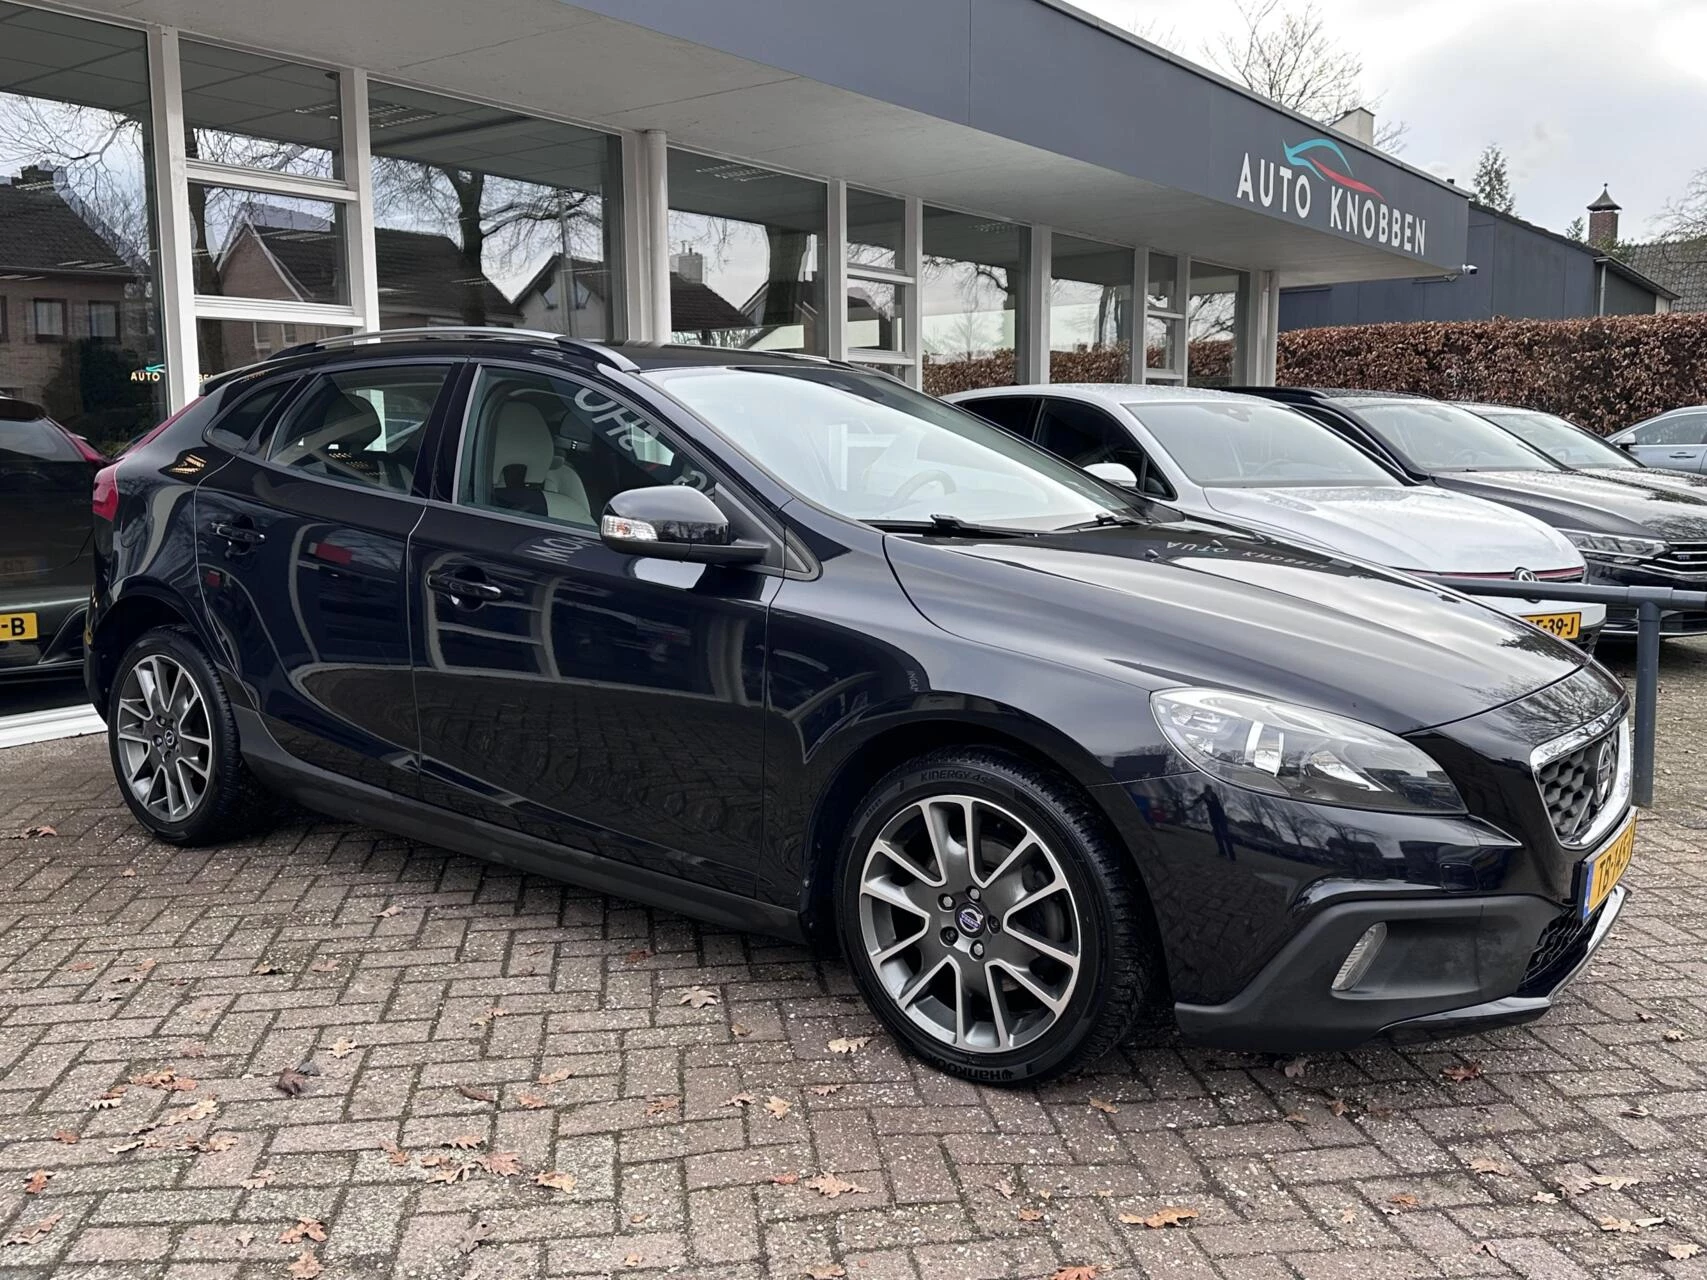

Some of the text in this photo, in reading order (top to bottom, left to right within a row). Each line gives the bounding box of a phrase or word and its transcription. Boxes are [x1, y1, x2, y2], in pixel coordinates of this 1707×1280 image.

[1236, 152, 1426, 256] AUTO KNOBBEN
[130, 372, 160, 382] AUTO
[1530, 616, 1575, 636] -39-J
